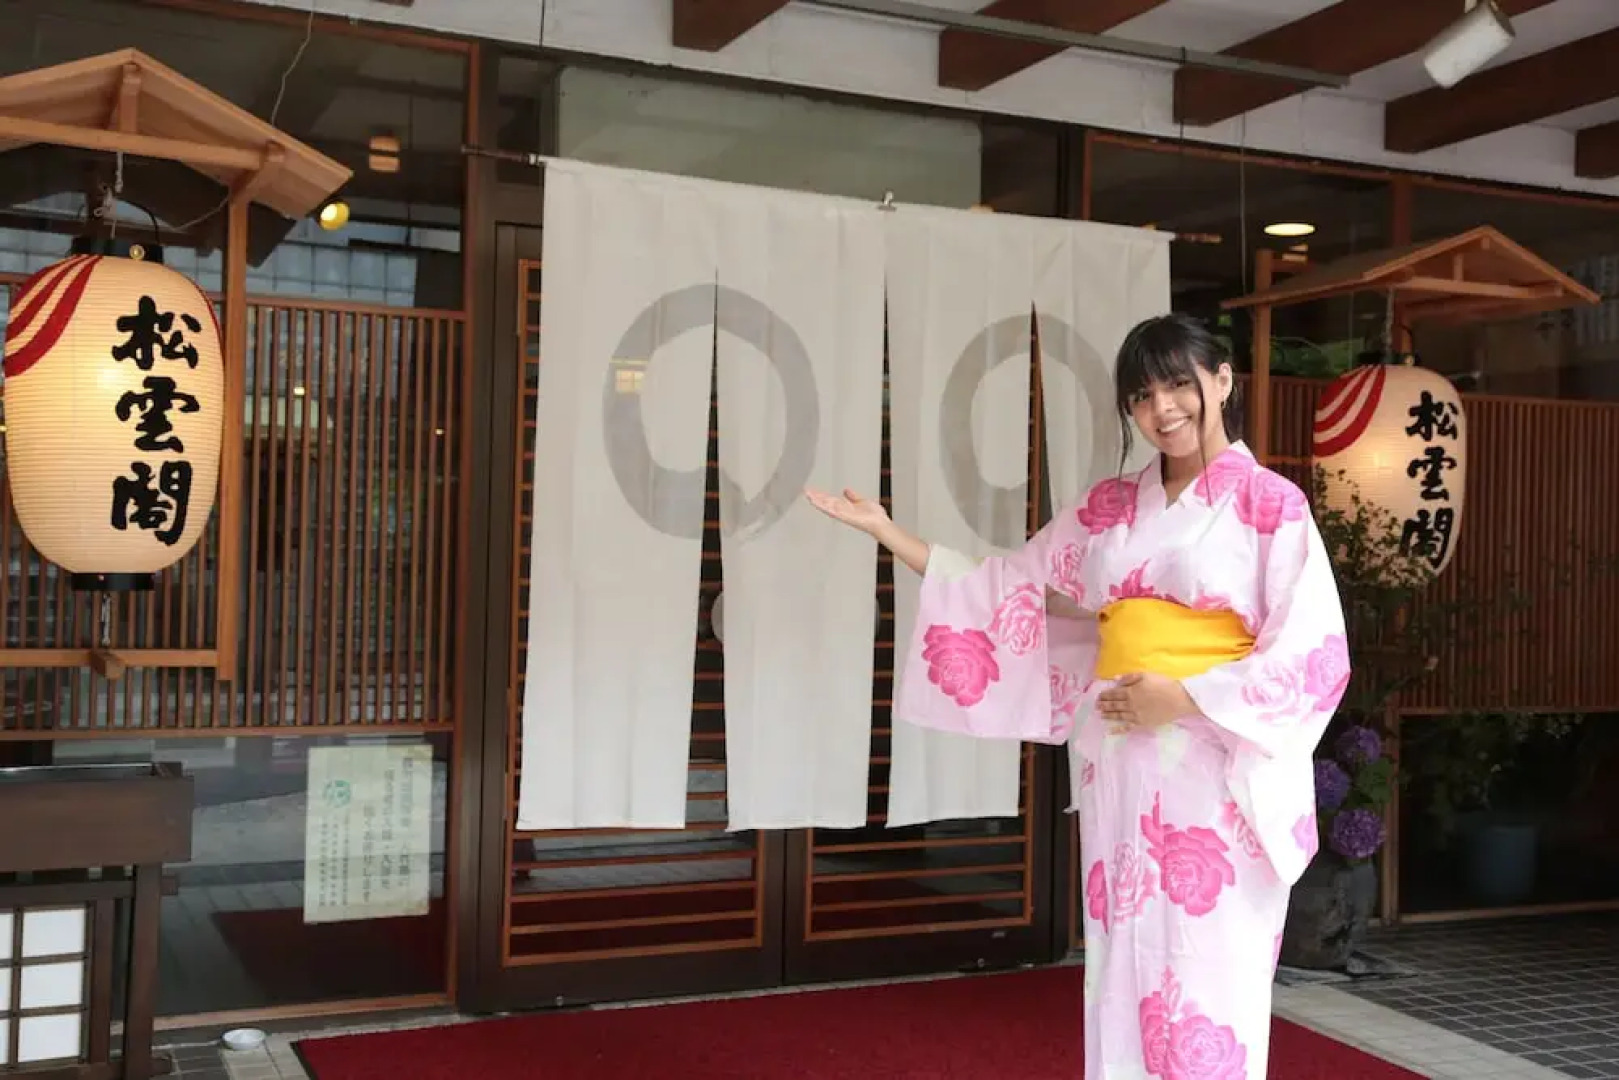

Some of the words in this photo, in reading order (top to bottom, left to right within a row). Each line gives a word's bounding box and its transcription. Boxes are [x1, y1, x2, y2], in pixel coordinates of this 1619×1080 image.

[111, 295, 202, 546] 松雲閣
[1401, 390, 1458, 568] 松雲閣
